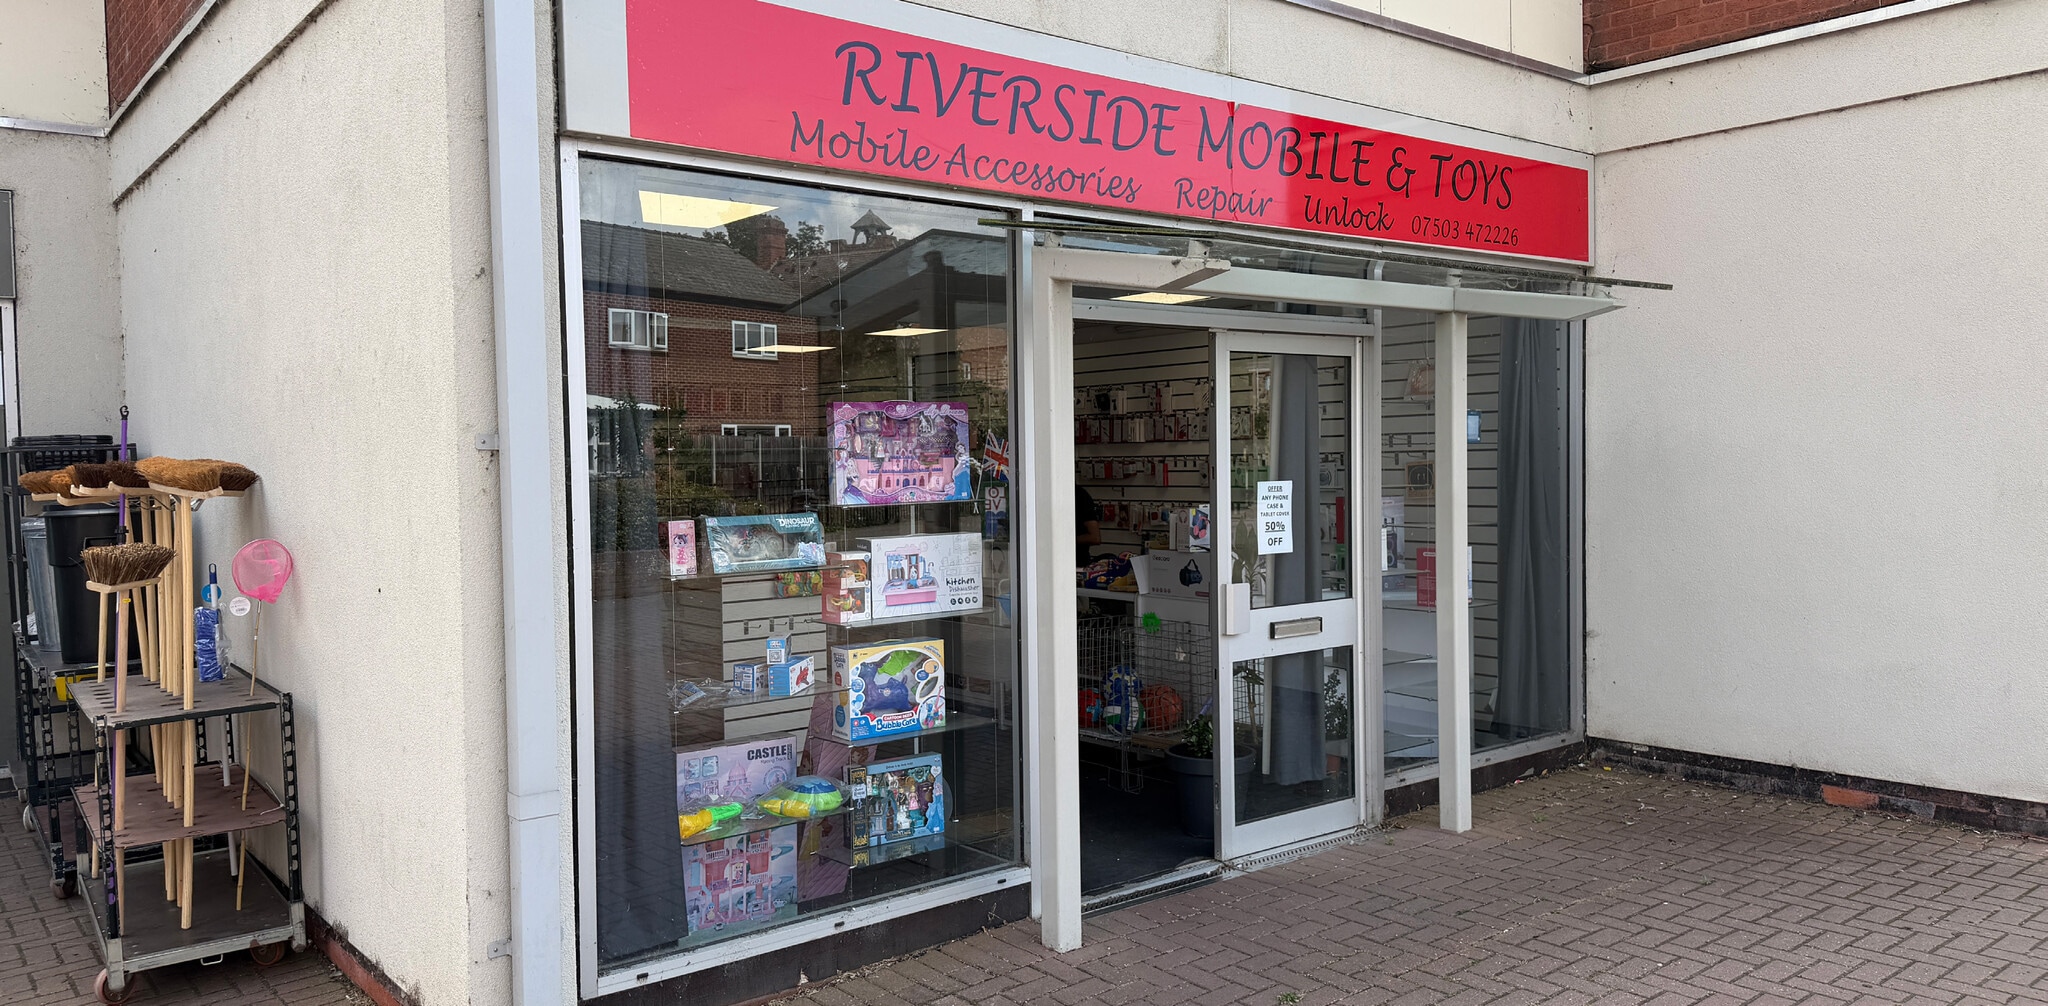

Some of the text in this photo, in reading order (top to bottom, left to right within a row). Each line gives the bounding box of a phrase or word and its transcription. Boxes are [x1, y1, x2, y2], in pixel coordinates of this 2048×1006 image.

[836, 41, 1513, 210] RIVERSIDE MOBILE & TOYS
[790, 111, 1519, 247] Mobile Accessories Repair Unlock 07503 472226
[776, 516, 815, 527] DINOSAUR
[1265, 520, 1286, 532] 50%
[1267, 537, 1283, 546] OFF
[946, 577, 976, 586] kitchen
[876, 718, 902, 731] Bubble
[747, 744, 787, 761] CASTLE
